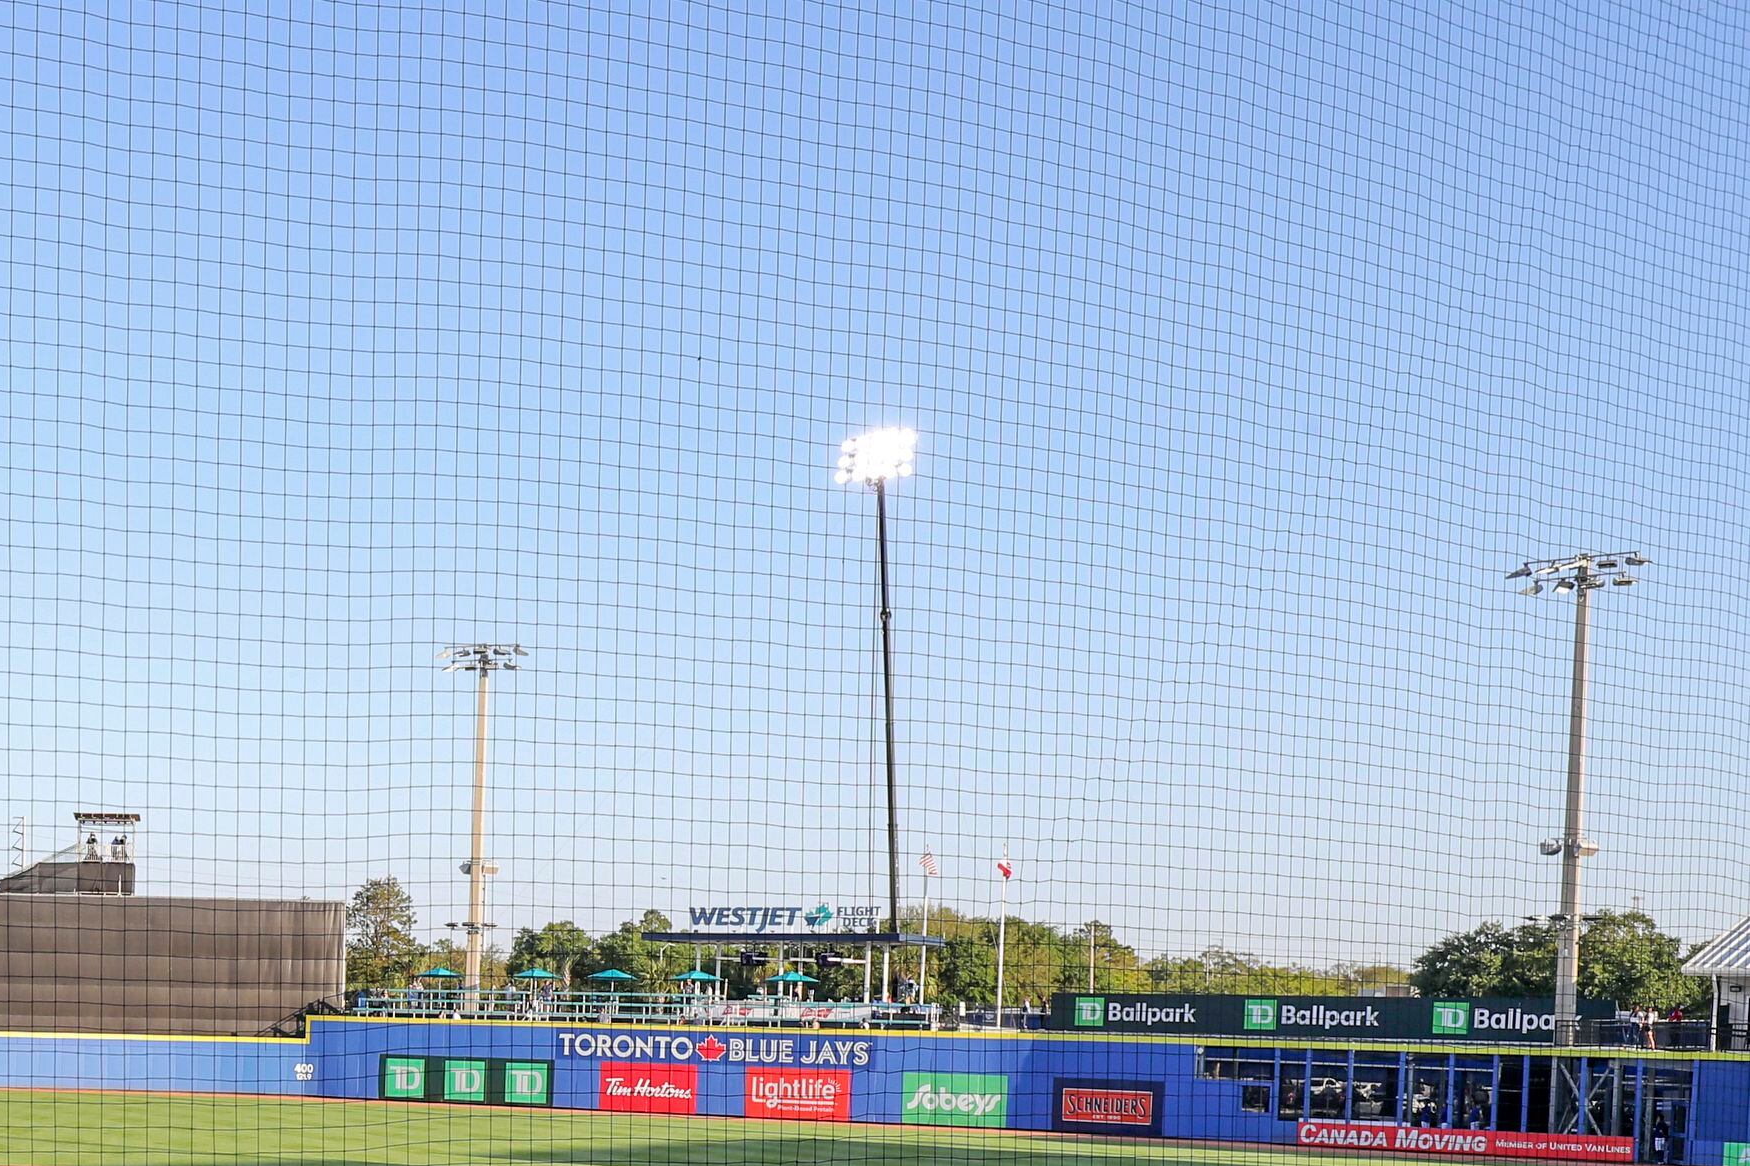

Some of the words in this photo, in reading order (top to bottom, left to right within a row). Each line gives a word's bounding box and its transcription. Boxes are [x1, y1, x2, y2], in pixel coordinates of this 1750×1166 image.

[689, 907, 802, 933] WESTJET
[837, 906, 881, 917] FLIGHT
[843, 917, 876, 928] DECK
[1078, 1001, 1100, 1020] TD
[1108, 1002, 1196, 1026] Ballpark
[1248, 1005, 1273, 1024] TD
[1281, 1005, 1379, 1030] Ballpark
[1437, 1008, 1465, 1028] TD
[559, 1033, 693, 1060] TORONTO
[729, 1038, 794, 1063] BLUE
[800, 1041, 869, 1066] JAYS
[294, 1063, 314, 1073] 400
[391, 1066, 420, 1090] TD
[451, 1068, 480, 1093] TD
[513, 1070, 543, 1096] TD
[605, 1077, 632, 1096] Tim
[906, 1083, 1001, 1116] Sobeys
[1300, 1125, 1388, 1146] CANADA
[1395, 1128, 1487, 1152] MOVING
